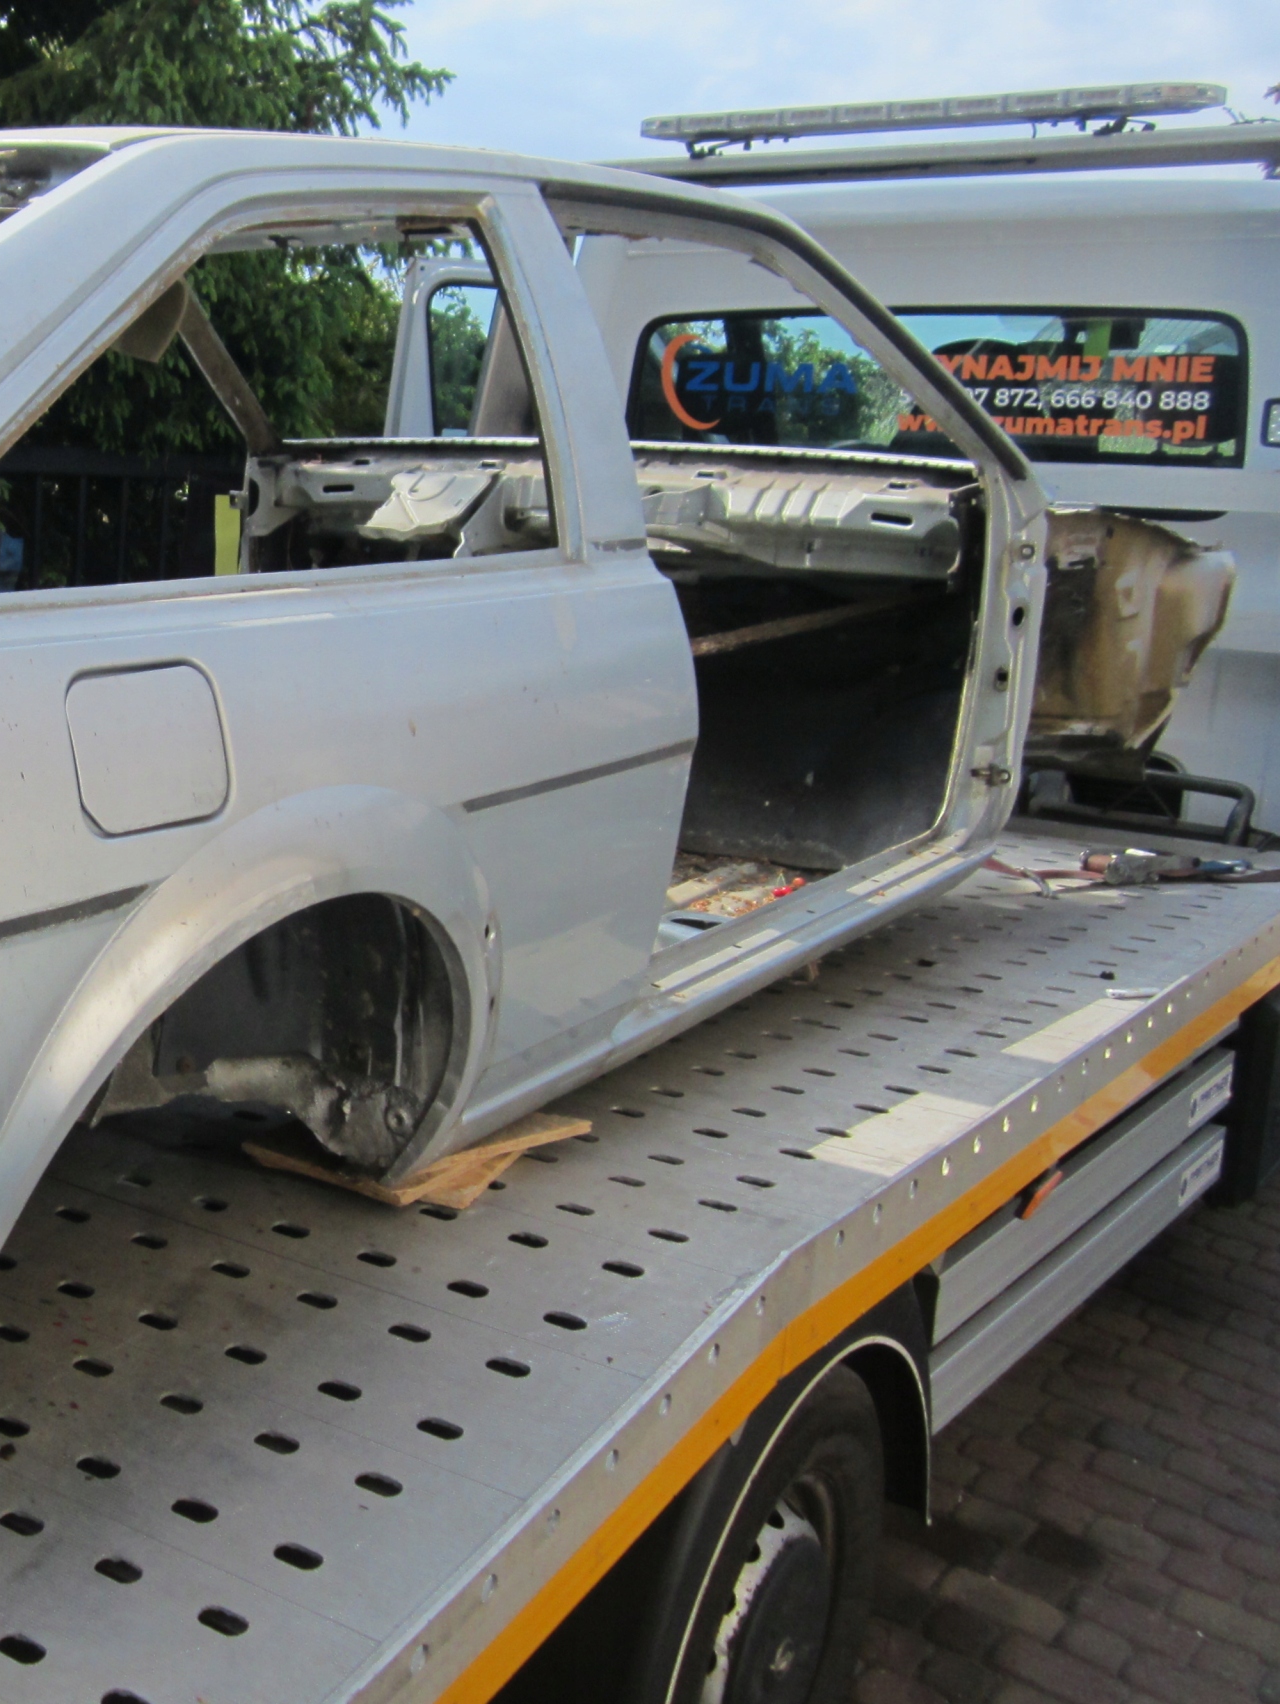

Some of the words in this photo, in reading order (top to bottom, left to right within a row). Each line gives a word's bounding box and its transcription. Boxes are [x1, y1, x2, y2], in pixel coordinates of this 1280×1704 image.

[685, 361, 857, 394] ZUMA
[933, 354, 1102, 381] YNAJMIJ
[1111, 355, 1216, 383] MNIE
[994, 387, 1043, 411] 872,
[1051, 388, 1096, 409] 666
[1102, 389, 1152, 410] 840
[1159, 390, 1210, 411] 888
